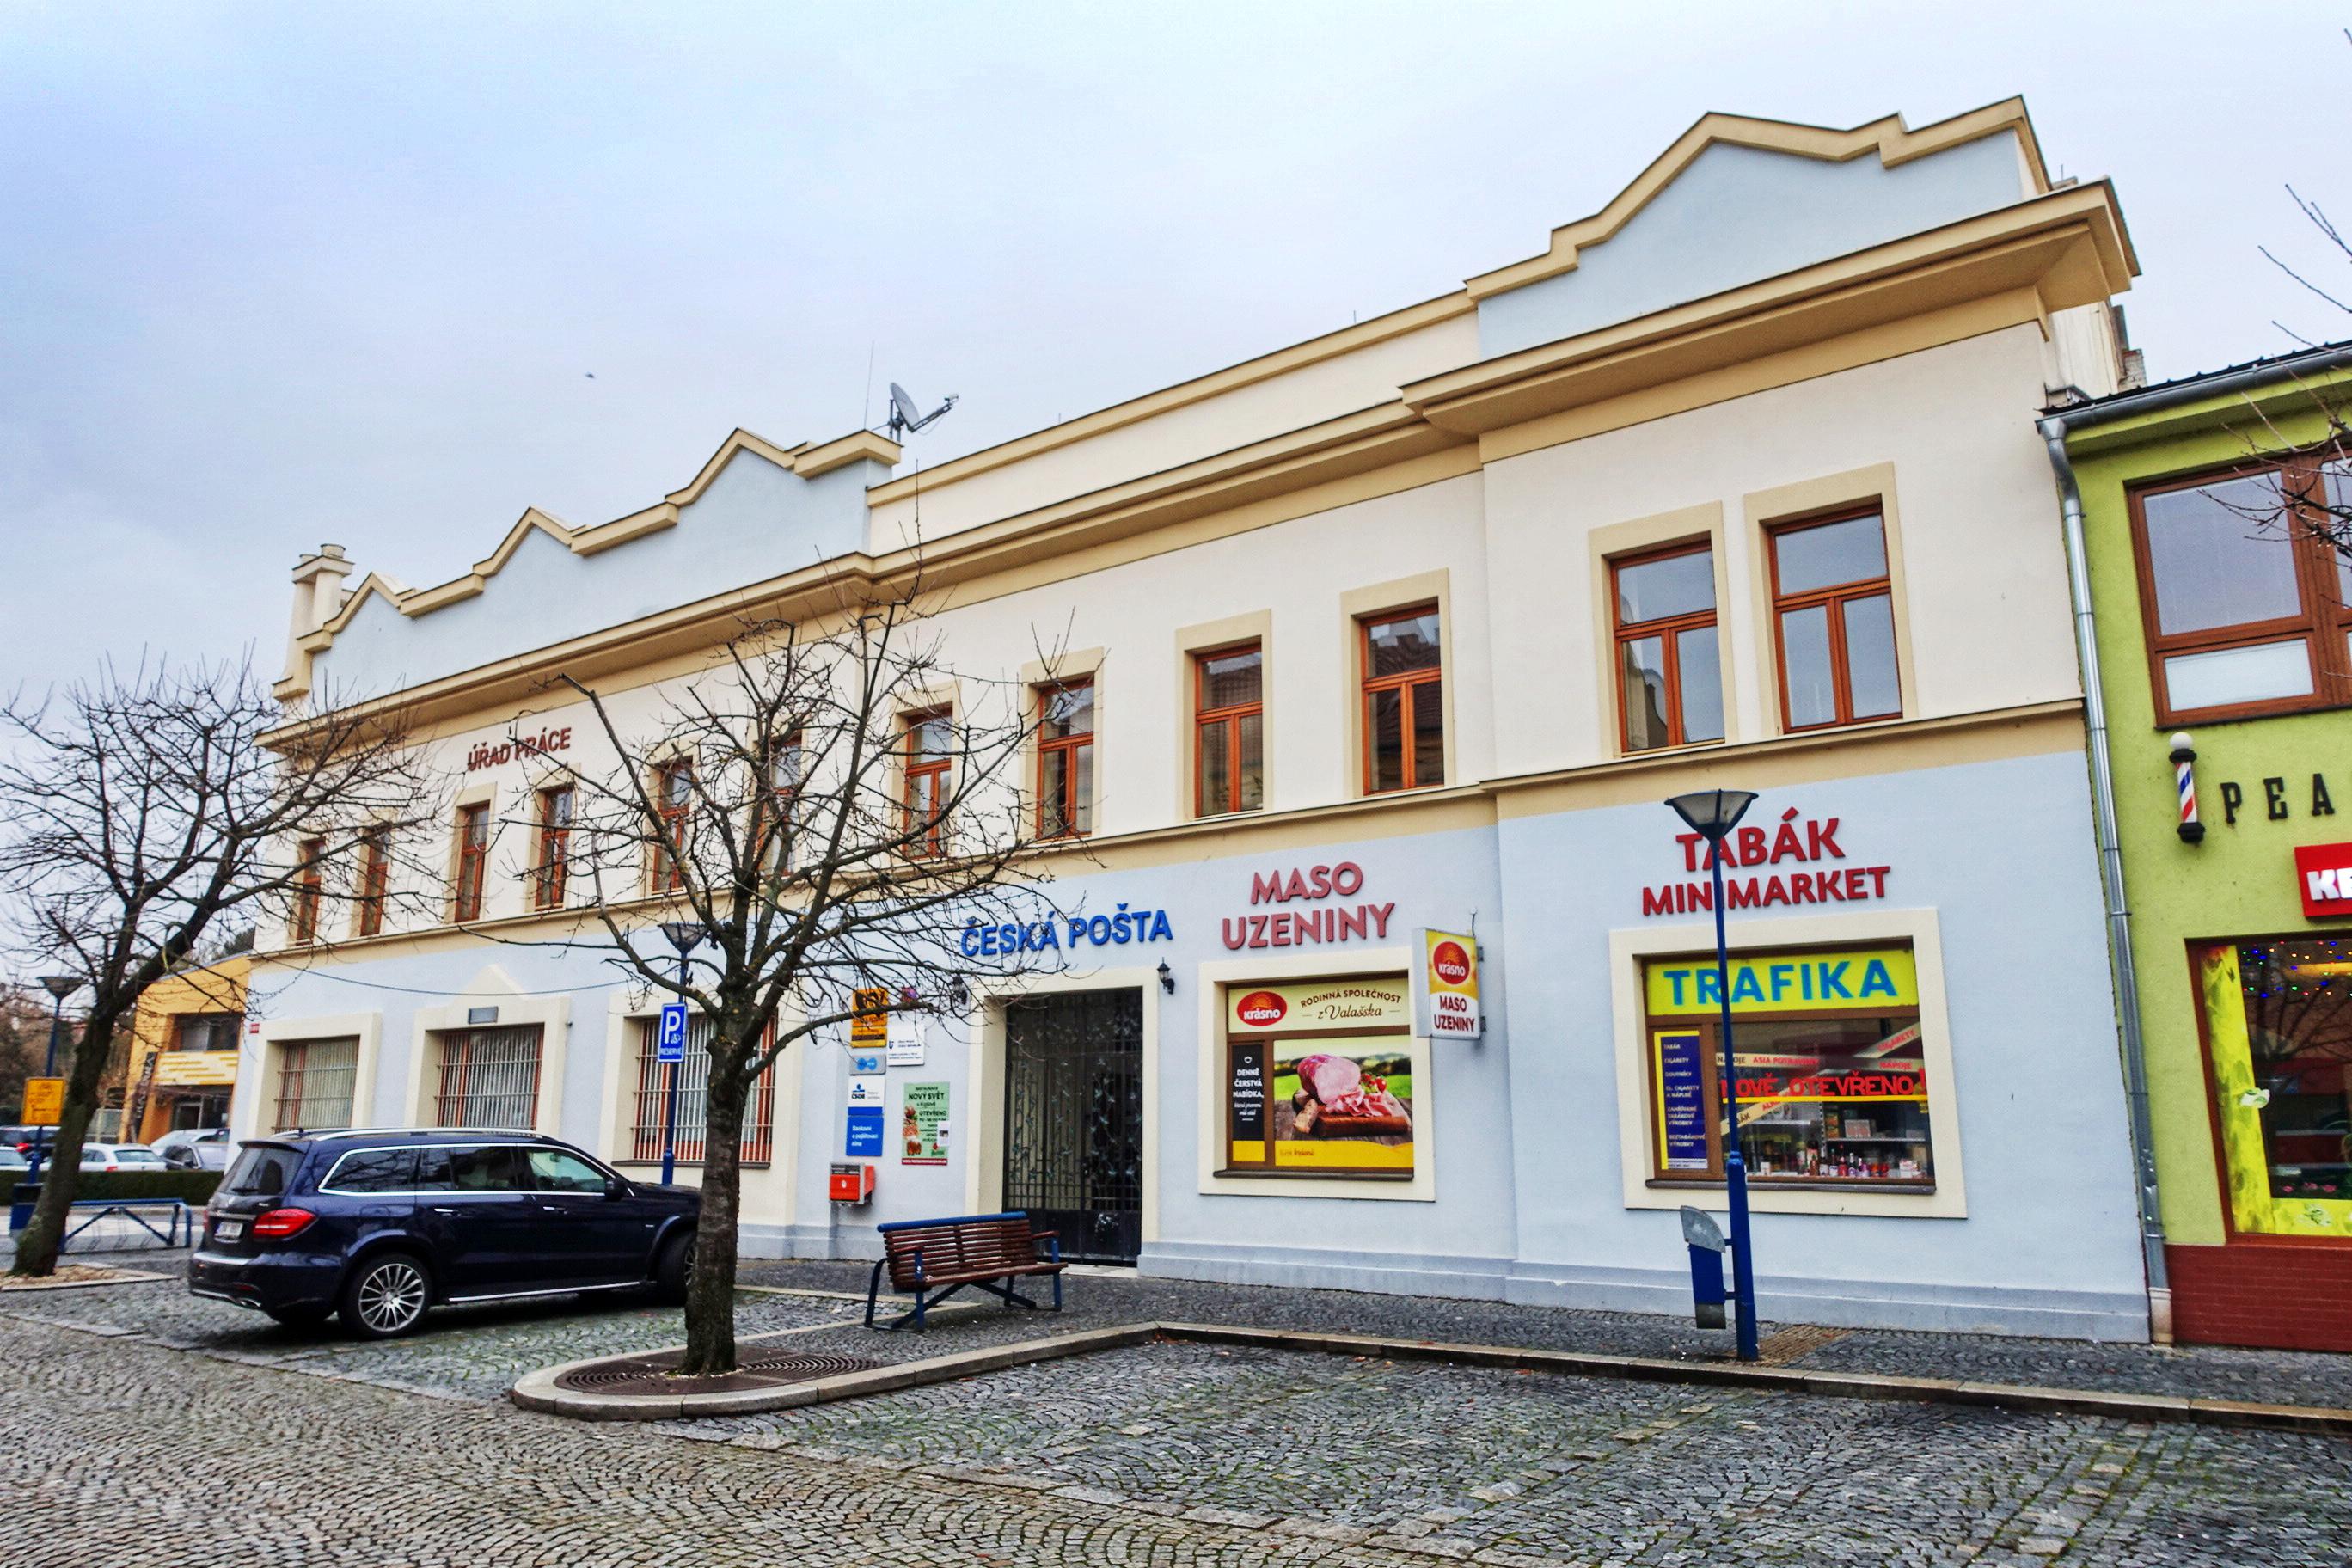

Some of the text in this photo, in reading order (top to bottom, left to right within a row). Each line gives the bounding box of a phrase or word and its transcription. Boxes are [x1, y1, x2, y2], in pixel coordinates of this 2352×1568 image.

[467, 726, 572, 771] ÚŘAD PRÁCE
[1675, 806, 1846, 872] TABÁK
[1250, 861, 1363, 905] MASO
[961, 903, 1173, 957] ČESKÁ POŠTA
[1222, 903, 1395, 950] UZENINY
[1663, 959, 1898, 1006] TRAFIKA
[1301, 988, 1402, 1008] RODINNÁ SPOLEČNOST
[1317, 1003, 1382, 1020] z Valašska
[1439, 995, 1467, 1012] MASO
[664, 1010, 681, 1044] P
[1434, 1014, 1475, 1032] UZENINY
[1234, 1078, 1263, 1087] ČERSTVÁ
[1237, 1068, 1260, 1076] DENNĚ
[908, 1091, 945, 1100] NOVÝ SVĚT
